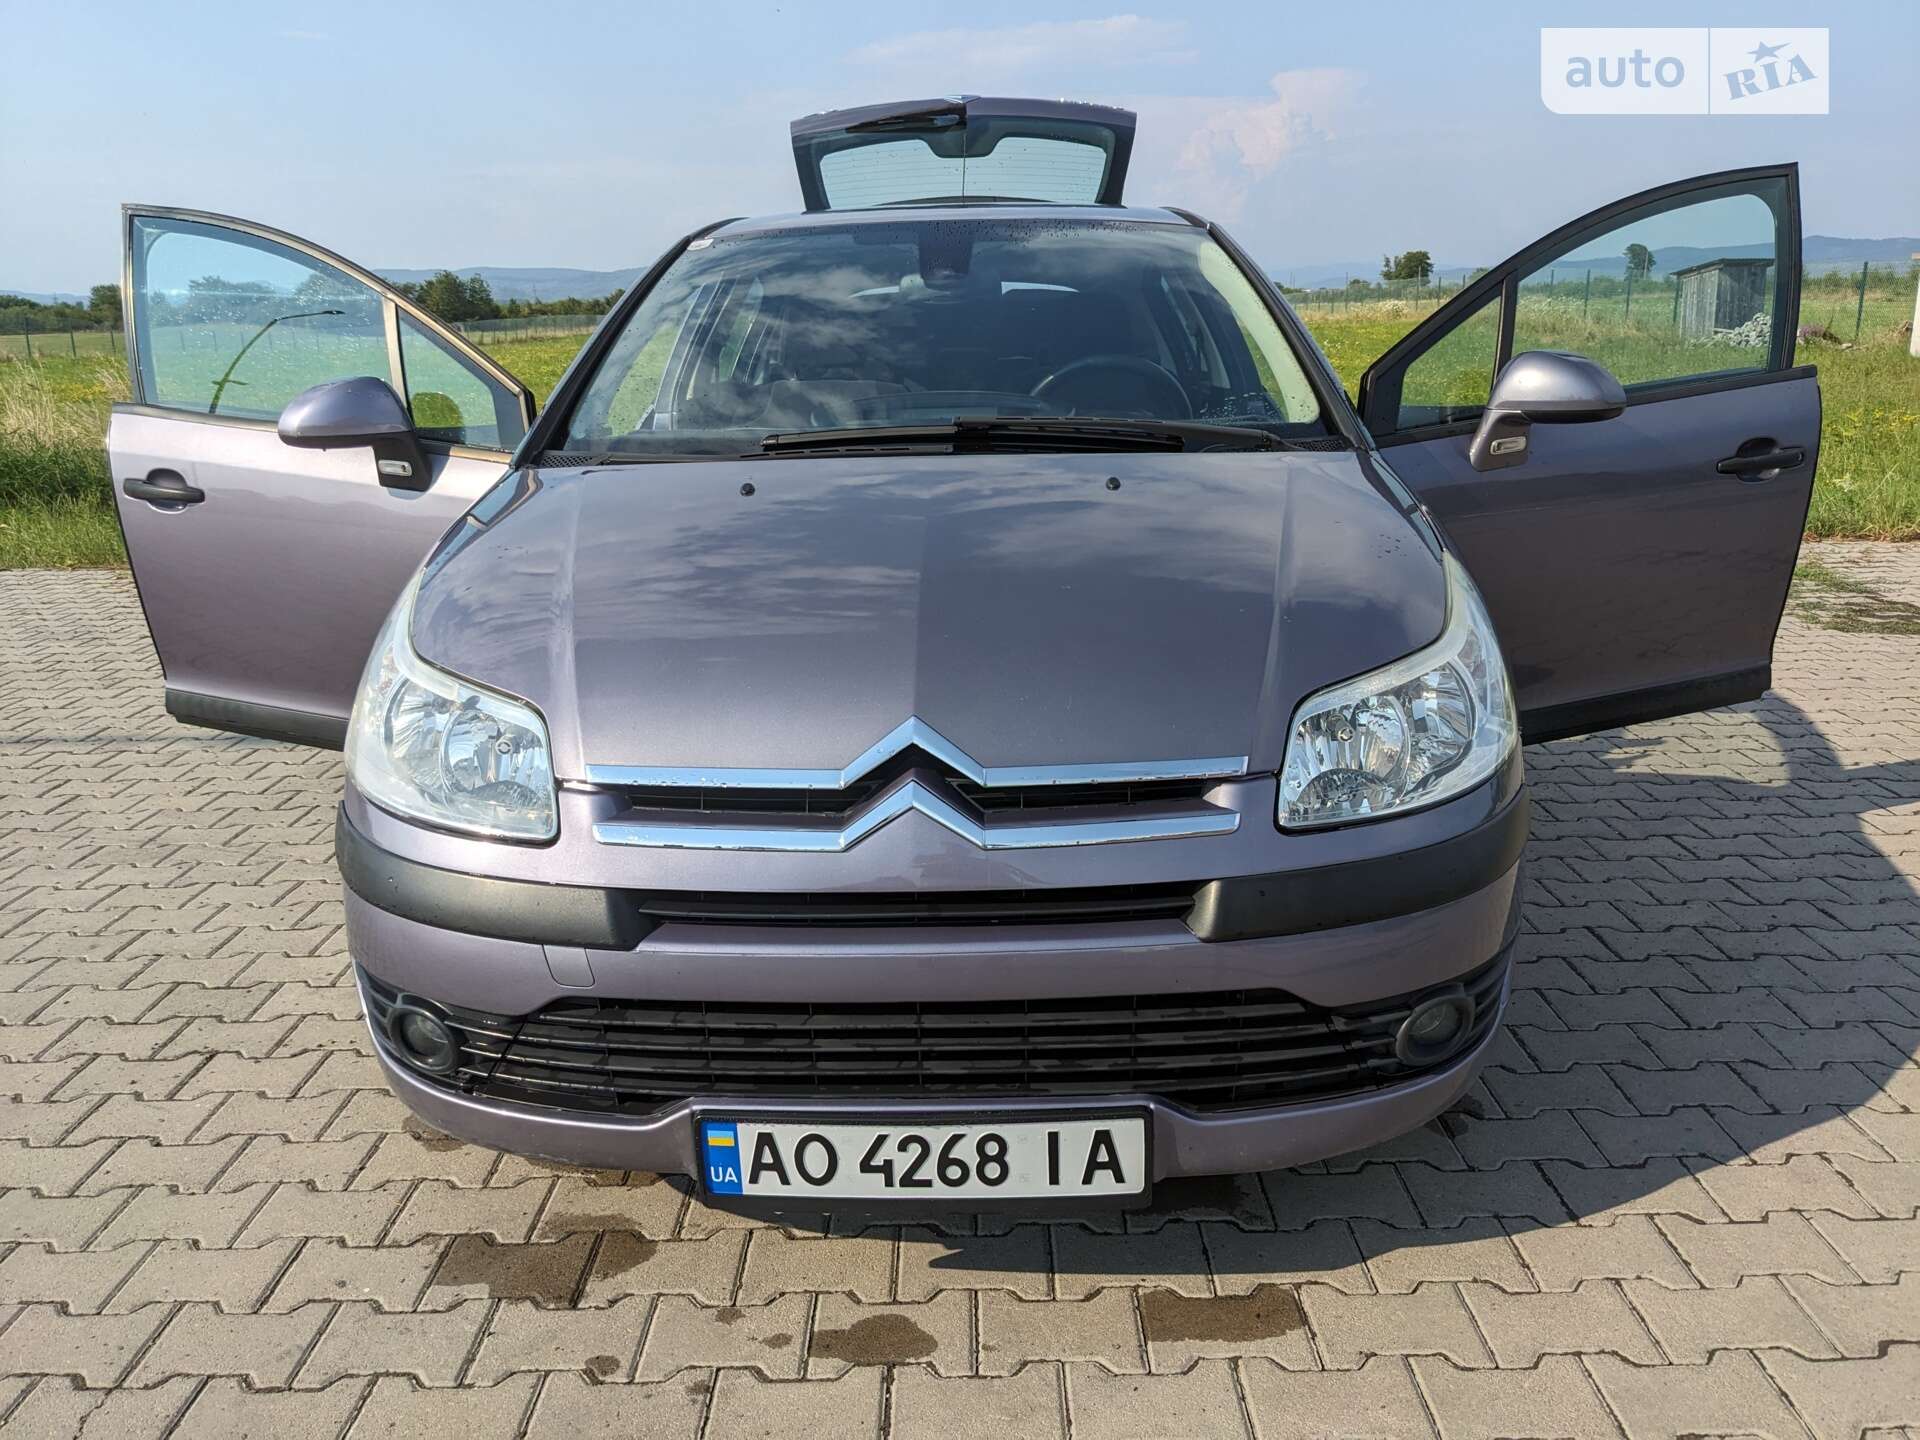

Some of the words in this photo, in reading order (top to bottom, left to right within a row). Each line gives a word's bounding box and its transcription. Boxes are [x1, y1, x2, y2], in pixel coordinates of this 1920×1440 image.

[710, 1167, 738, 1184] UA
[748, 1132, 838, 1186] AO
[859, 1132, 1009, 1188] 4268
[1047, 1129, 1126, 1186] IA
